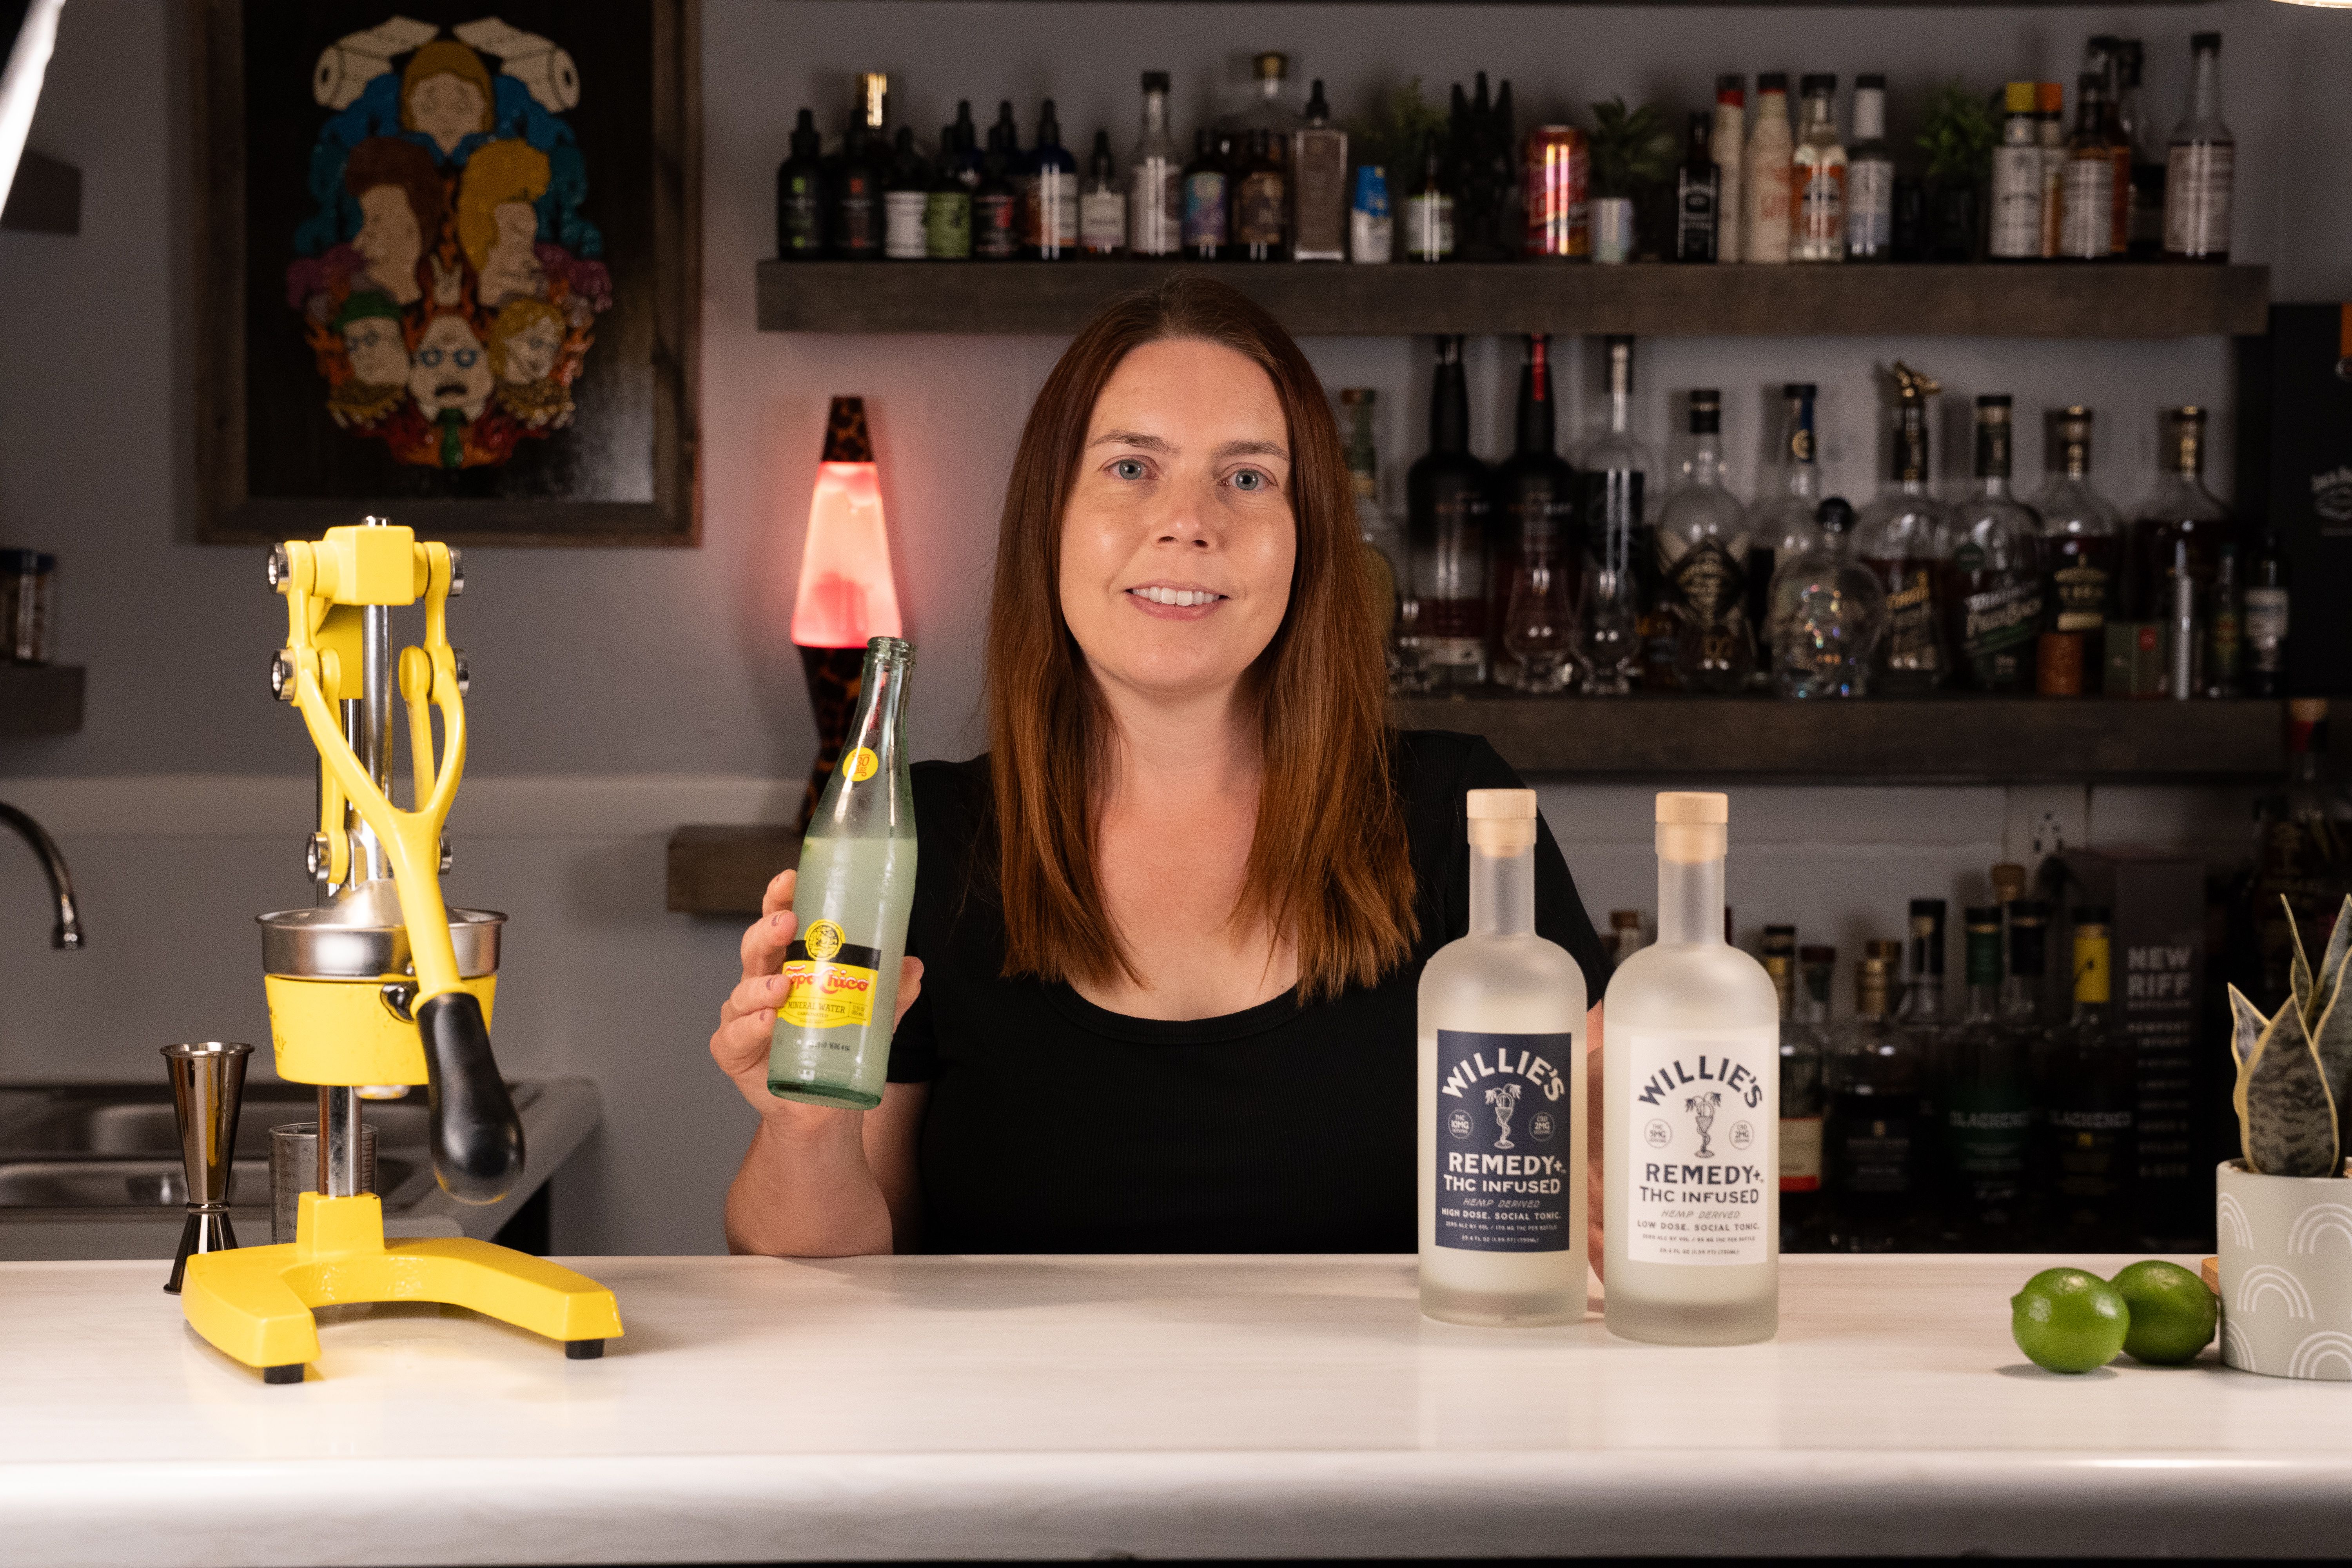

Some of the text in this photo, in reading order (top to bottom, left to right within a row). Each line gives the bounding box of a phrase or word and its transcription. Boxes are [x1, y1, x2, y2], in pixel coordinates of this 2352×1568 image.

[857, 756, 869, 767] 30
[2127, 945, 2192, 970] NEW
[819, 966, 869, 994] Chico
[2127, 973, 2192, 997] RIFF
[788, 1001, 845, 1013] MINERAL WATER
[1441, 1047, 1565, 1102] WILLIE'S
[1637, 1055, 1762, 1108] WILLIE'S
[1451, 1120, 1469, 1129] 10MG
[1534, 1122, 1550, 1130] 2MG
[1443, 1174, 1561, 1194] THC INFUSED
[1639, 1186, 1759, 1203] THC INFUSED
[1463, 1198, 1541, 1208] HEMP DERIVED
[1441, 1207, 1562, 1220] HIGH DOSE. SOCIAL TONIC.
[1661, 1209, 1741, 1219] HEMP DERIVED
[1637, 1220, 1655, 1229] LOW
[1661, 1222, 1690, 1231] DOSE.
[1734, 1222, 1759, 1231] TONIC.
